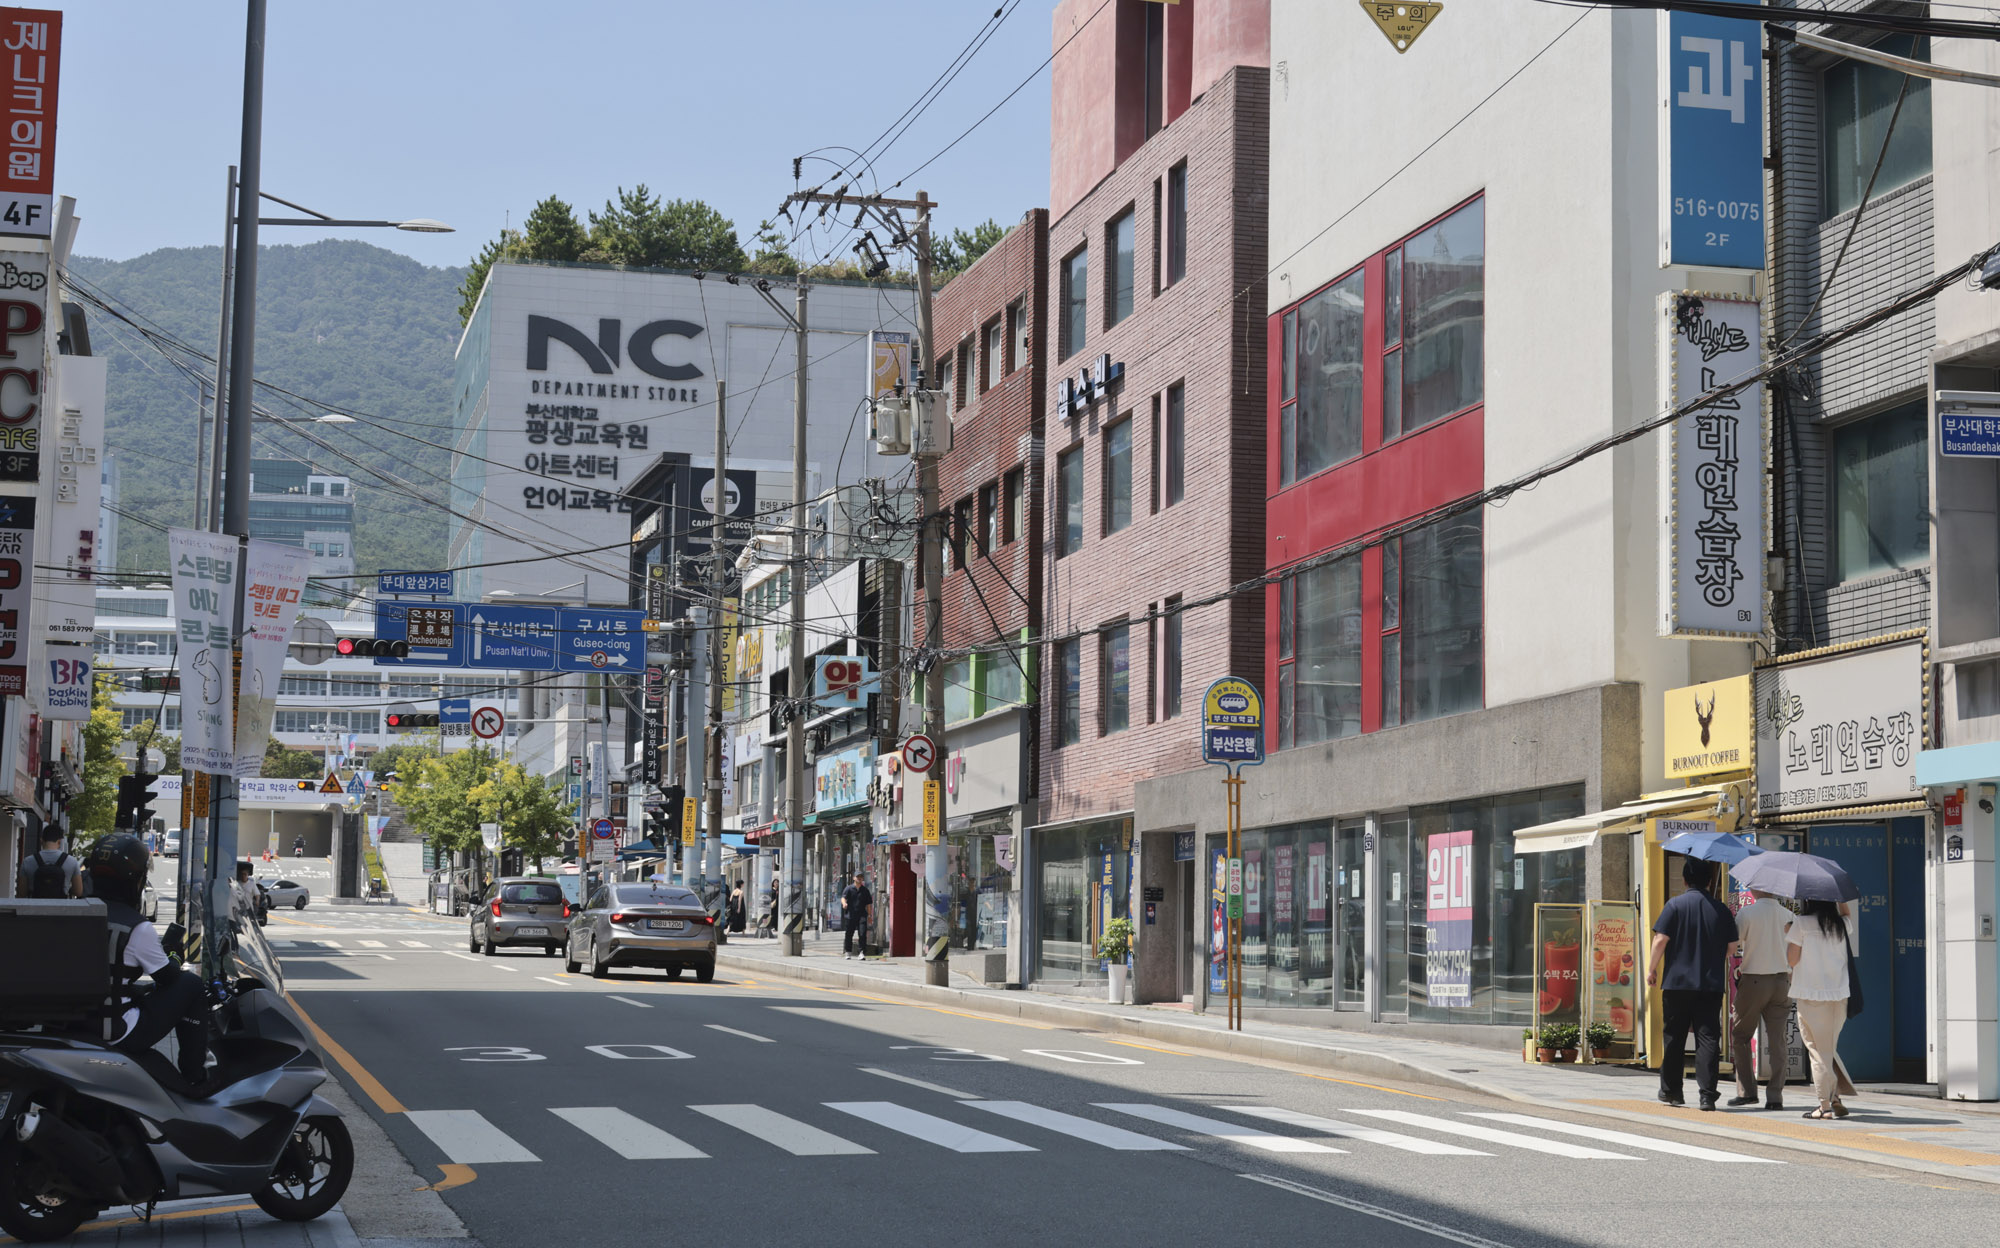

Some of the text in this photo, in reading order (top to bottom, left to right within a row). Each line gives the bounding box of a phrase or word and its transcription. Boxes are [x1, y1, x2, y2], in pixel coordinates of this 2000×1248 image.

[1678, 36, 1753, 124] 과
[4, 21, 48, 181] 제니크의원
[3, 201, 42, 226] 4F
[1674, 197, 1760, 221] 516-0075
[1705, 232, 1730, 247] 2F
[526, 314, 704, 380] NC
[532, 380, 699, 403] DEPARTMENT STORE
[525, 403, 599, 422] 부산대학교
[525, 420, 648, 450] 평생교육원
[524, 452, 618, 481] 아트센터
[1694, 367, 1743, 608] 노래연습장
[178, 553, 232, 584] 스탠딩
[382, 575, 450, 591] 부대앞삼거리
[1737, 610, 1751, 622] B1
[49, 624, 61, 632] 051
[486, 621, 554, 638] 부산대학교
[578, 619, 627, 636] 구서동
[408, 634, 452, 648] Oncheonjang
[573, 638, 631, 652] Guseo-dong
[485, 646, 550, 658] Pusan Nat'l Univ.
[50, 659, 89, 685] BR
[824, 661, 862, 701] 약
[48, 687, 88, 698] baskin
[48, 697, 88, 708] robbins
[1213, 715, 1255, 724] 부산대학교
[440, 723, 471, 736] 일방통행
[1213, 737, 1255, 753] 부산은행
[1786, 711, 1915, 775] 노래연습장
[1672, 748, 1740, 771] BURNOUT COFFEE
[162, 780, 182, 790] 202
[239, 782, 265, 792] 대학교
[1910, 776, 1921, 791] B
[1663, 821, 1709, 831] BURNOUT
[1948, 847, 1961, 859] 50
[1428, 845, 1472, 910] 임대
[1597, 923, 1627, 934] Peach
[1593, 933, 1634, 944] Plum Juice
[1543, 969, 1579, 980] 수박 주스
